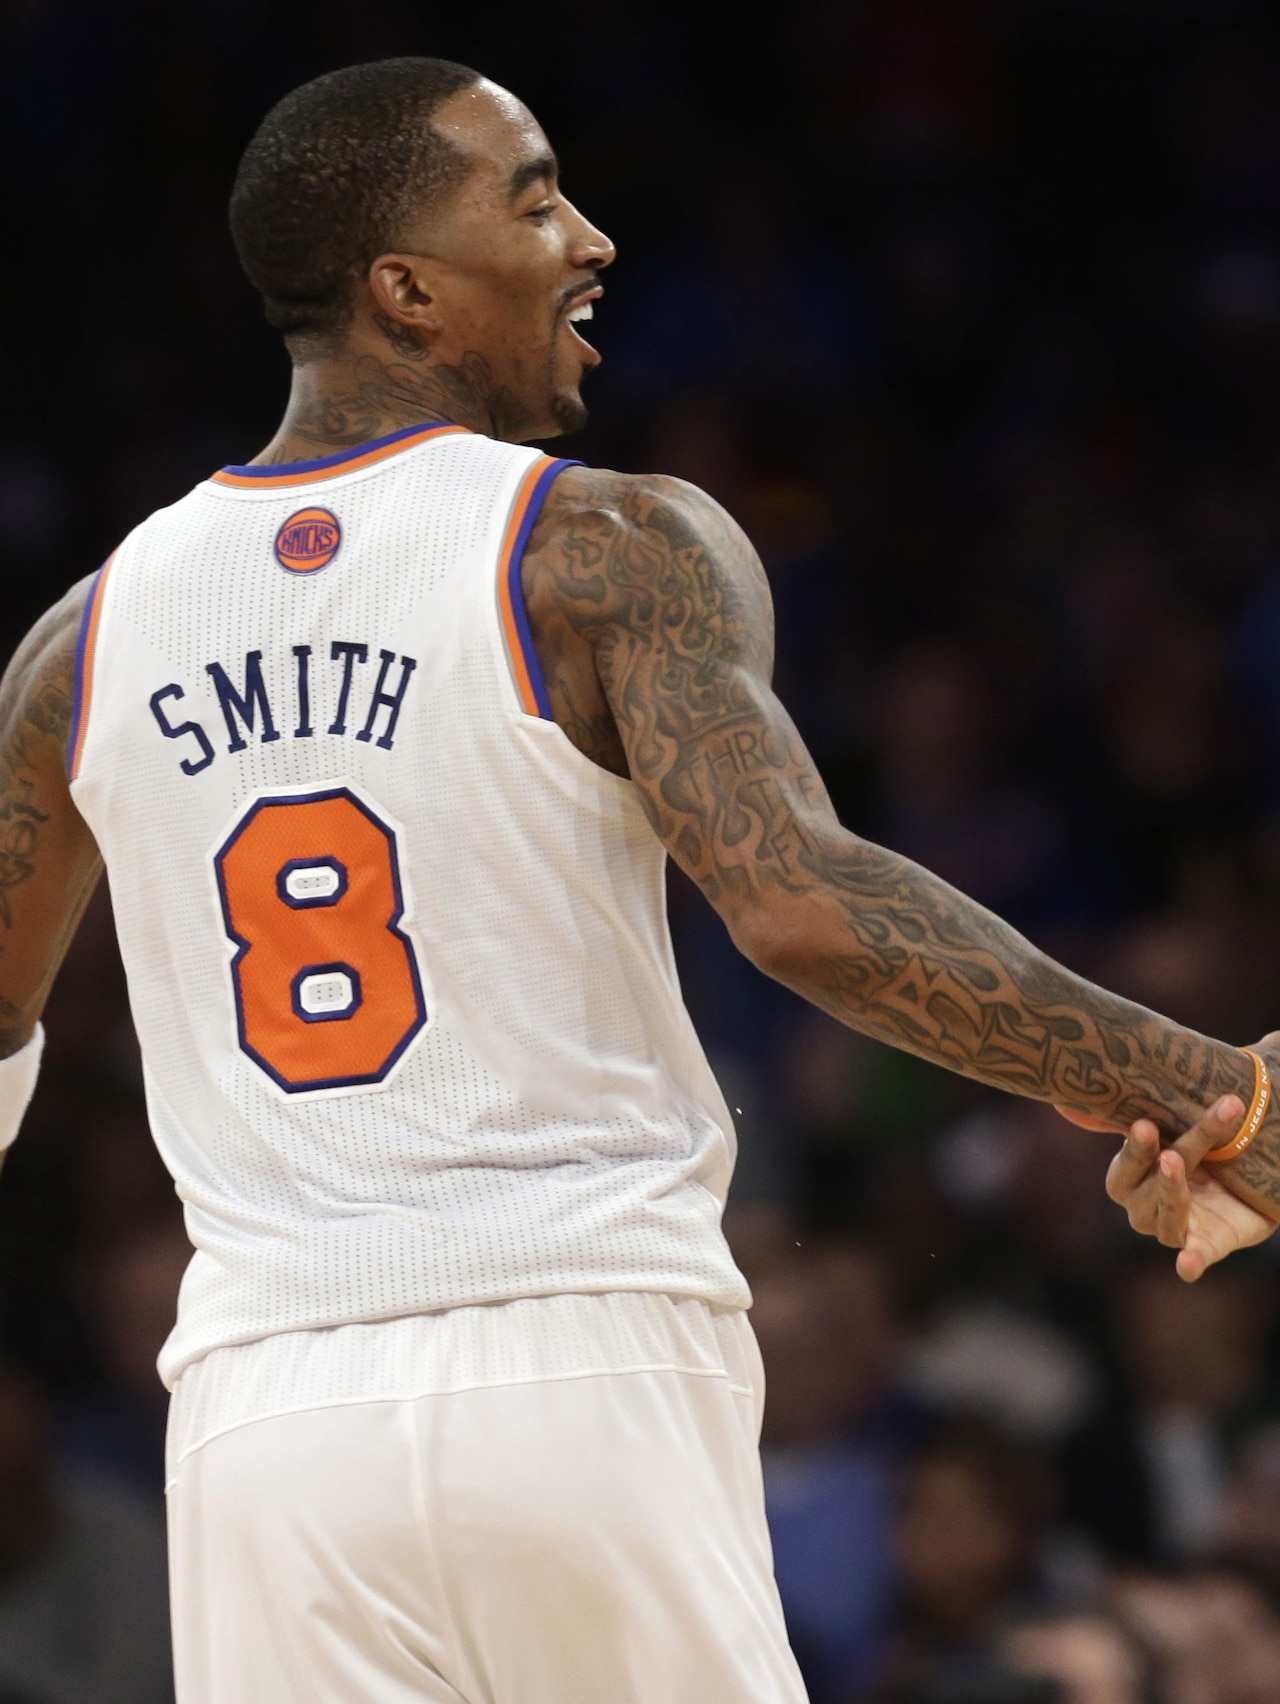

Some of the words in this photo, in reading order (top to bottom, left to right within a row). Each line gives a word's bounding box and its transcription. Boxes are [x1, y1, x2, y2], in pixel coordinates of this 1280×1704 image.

[282, 525, 333, 555] KNICKS
[149, 641, 417, 777] SMITH
[212, 785, 428, 1095] 8
[1235, 1135, 1249, 1150] IN
[1249, 1088, 1268, 1133] JESUS
